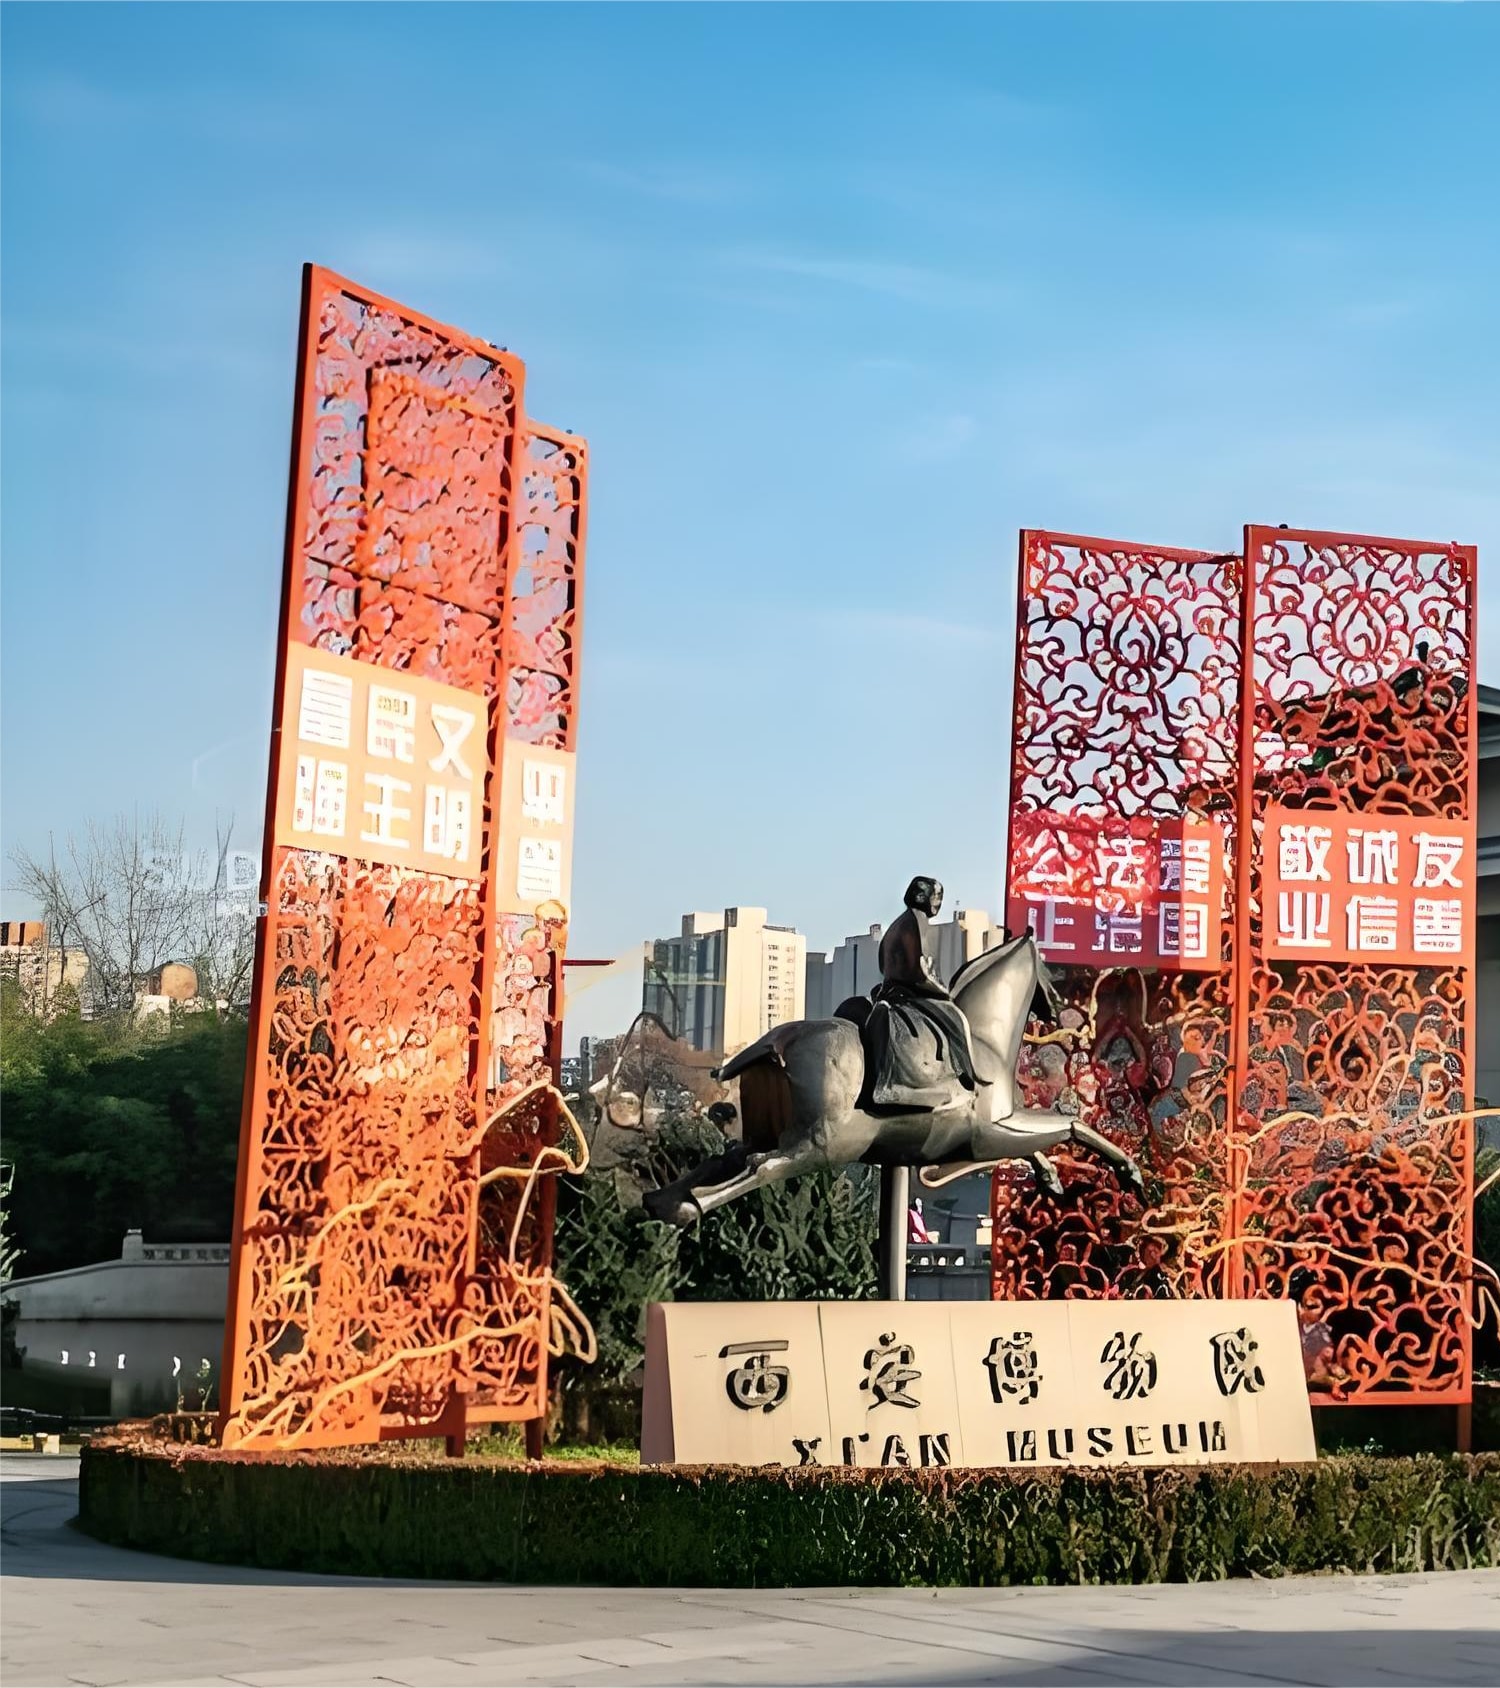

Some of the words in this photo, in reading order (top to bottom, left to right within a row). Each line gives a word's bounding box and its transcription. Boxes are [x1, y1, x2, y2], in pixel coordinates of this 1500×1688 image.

[1277, 824, 1332, 948] 敬业
[1345, 827, 1399, 952] 诚信
[718, 1326, 1266, 1413] 西安博物院
[1005, 1420, 1228, 1462] MUSEUM
